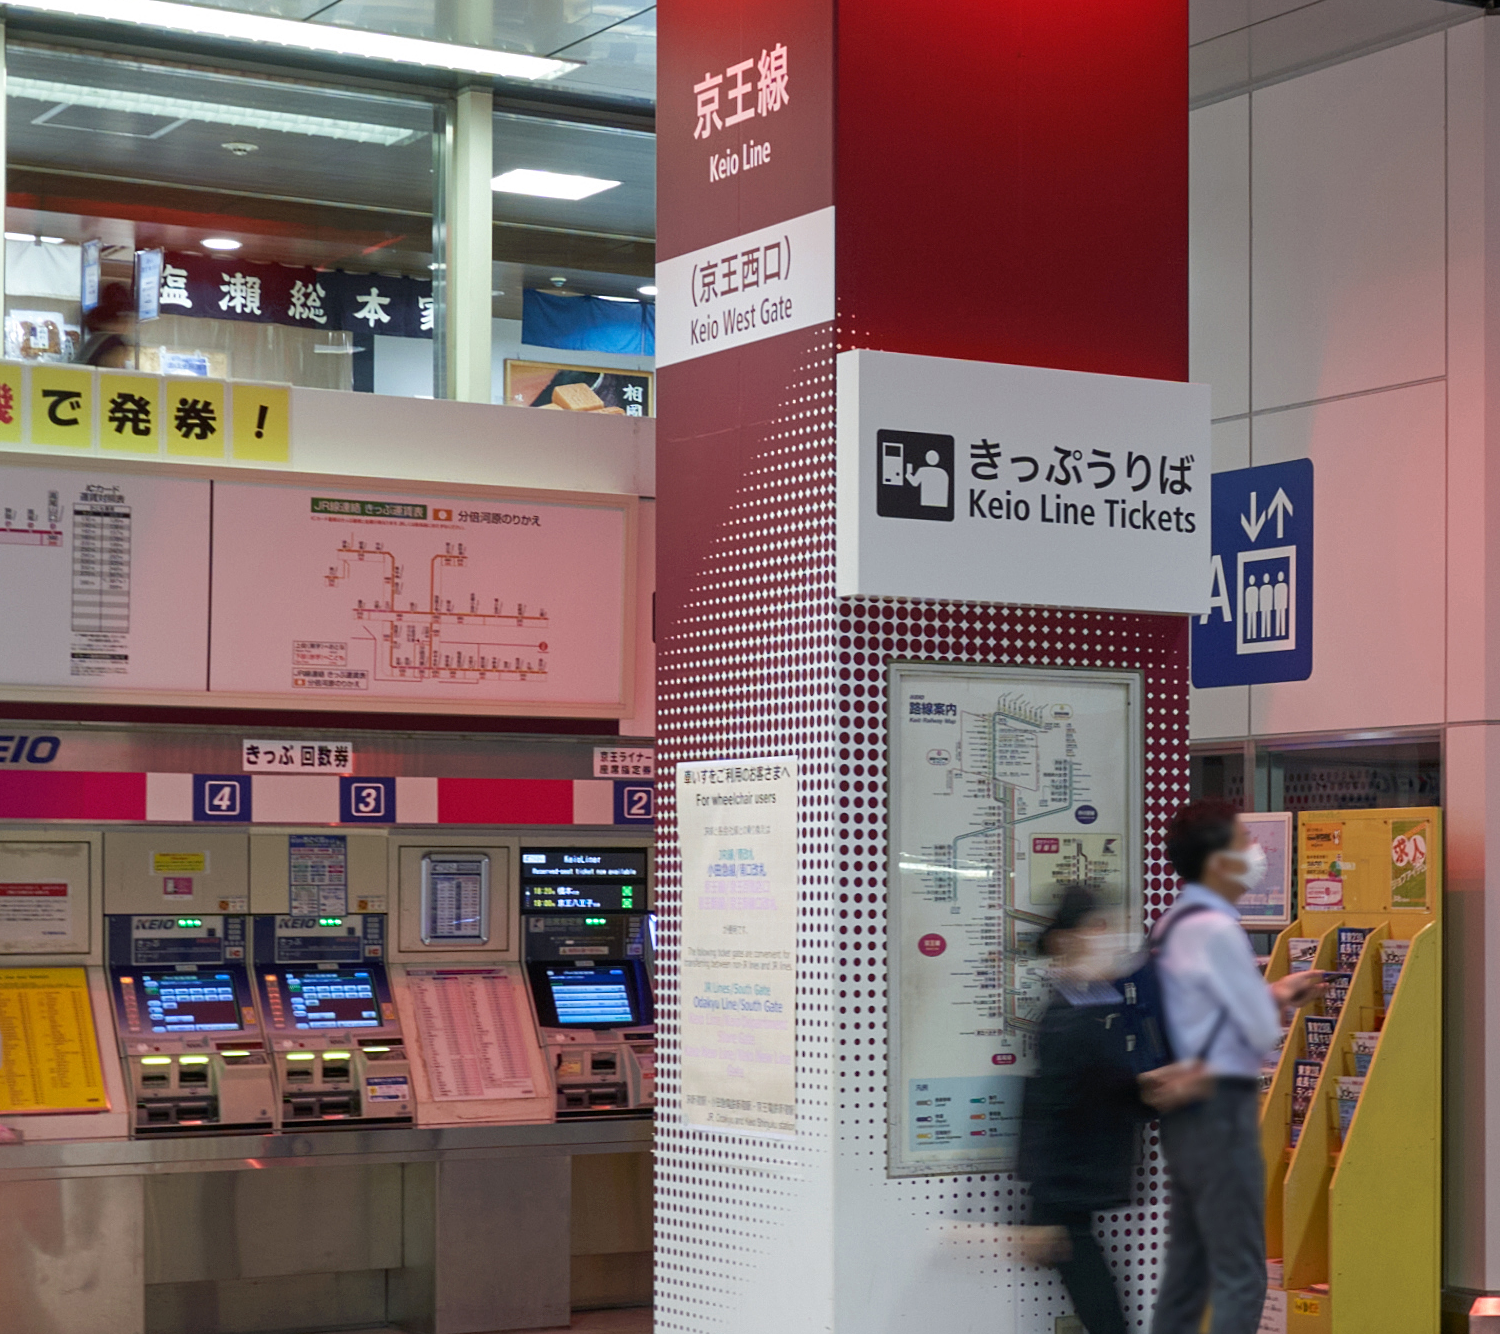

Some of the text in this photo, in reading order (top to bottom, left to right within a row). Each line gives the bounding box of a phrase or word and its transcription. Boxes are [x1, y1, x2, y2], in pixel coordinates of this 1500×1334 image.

[692, 42, 791, 142] 京王線
[708, 138, 771, 183] Keio Line
[690, 294, 793, 346] Keio West Gate
[969, 437, 1195, 496] きっぷうりば
[457, 510, 542, 527] 分倍河原のりかえ
[969, 487, 1197, 535] Keio Line Tickets
[1200, 554, 1232, 626] A
[244, 745, 350, 769] きっぷ 回数券
[212, 786, 232, 811] 4
[359, 788, 378, 812] 3
[630, 791, 649, 815] 2
[1392, 836, 1426, 866] 求人
[135, 918, 176, 930] KEIO
[278, 918, 317, 929] KEIO
